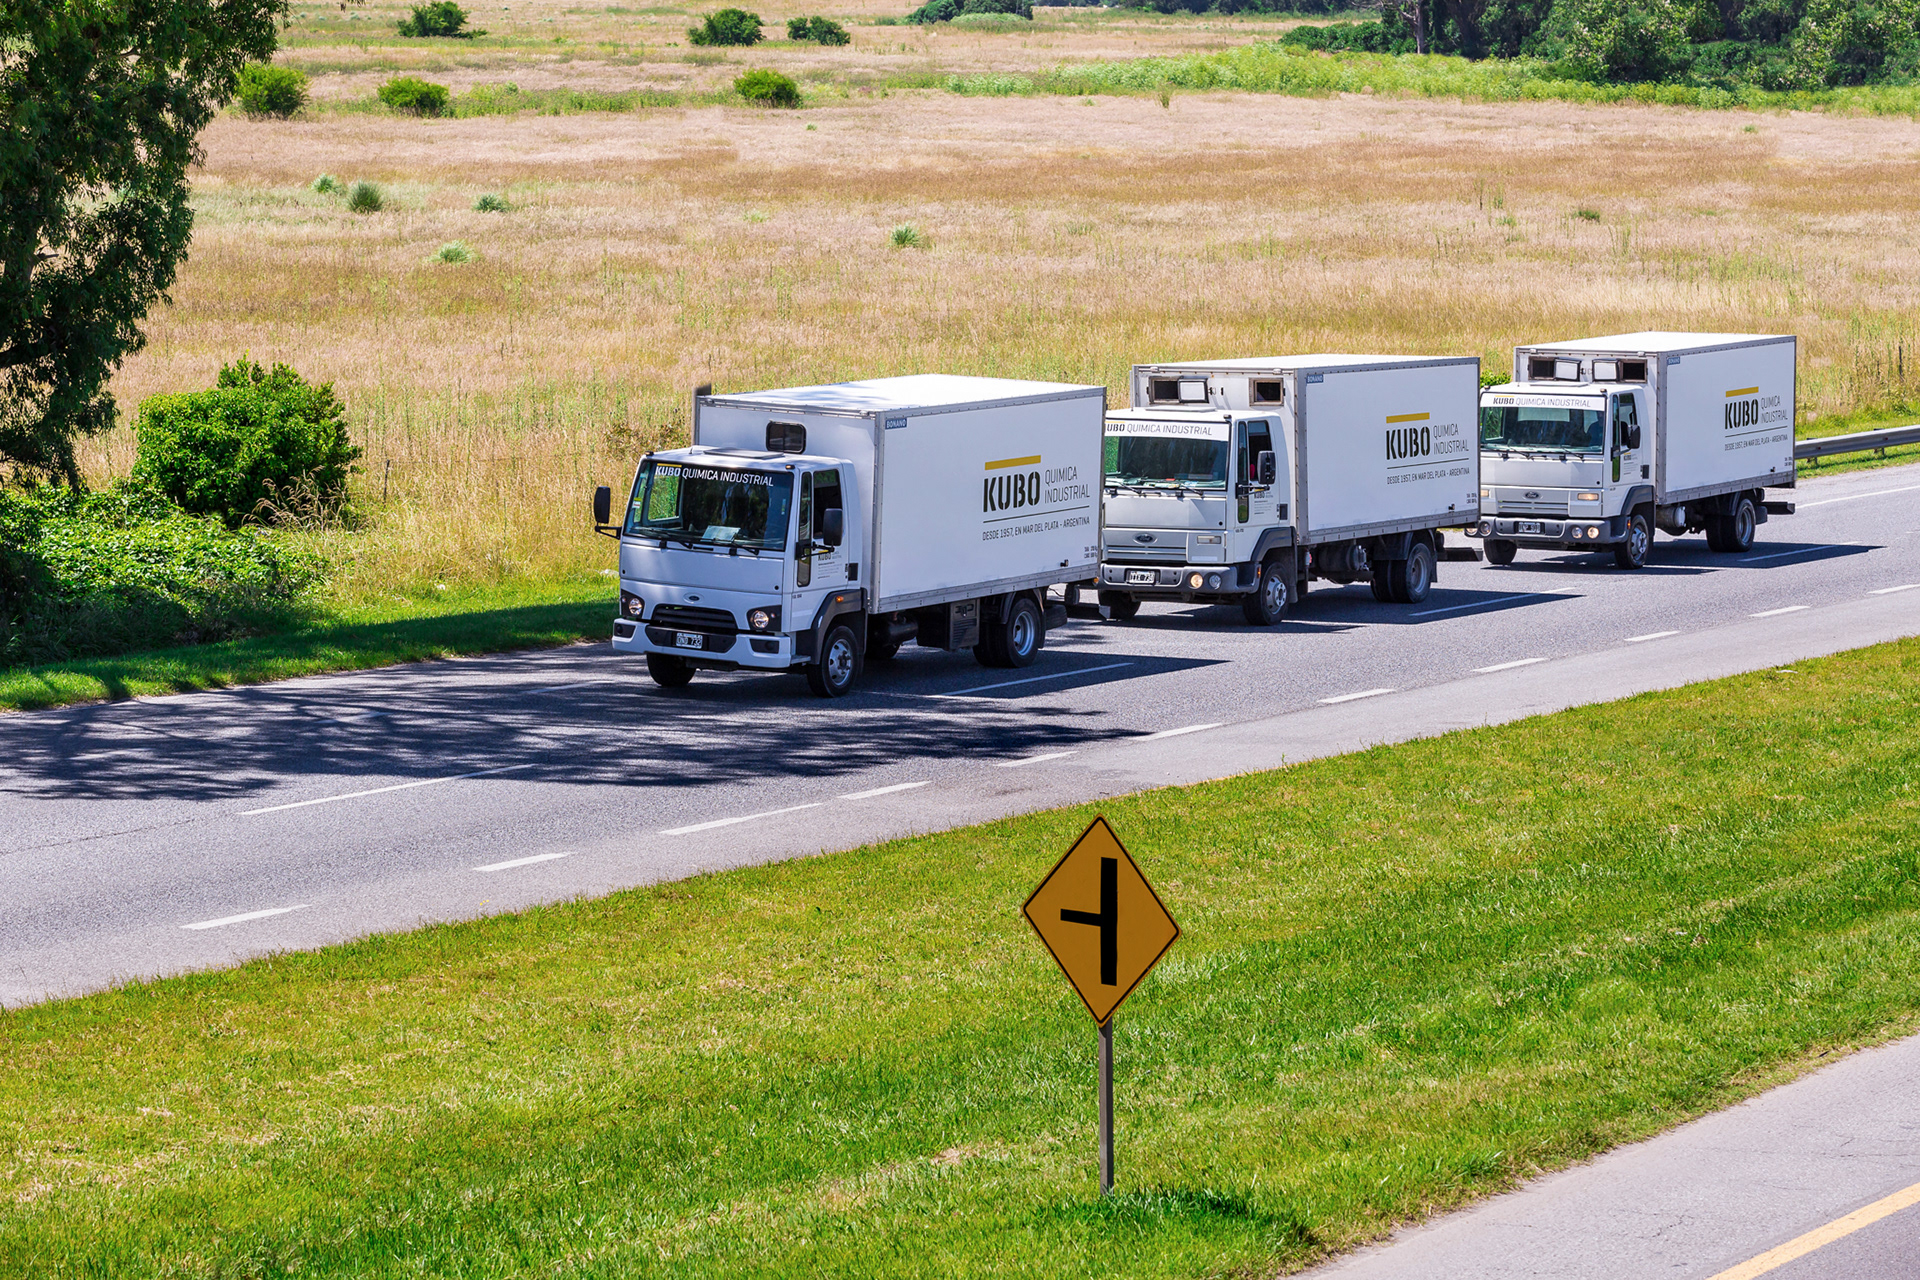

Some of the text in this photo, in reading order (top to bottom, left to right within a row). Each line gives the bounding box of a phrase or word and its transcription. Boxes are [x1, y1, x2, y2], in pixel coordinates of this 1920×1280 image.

[1493, 397, 1591, 407] KUBO QUIMICA INDUSTRIAL
[1725, 399, 1758, 429] KUBO
[1105, 423, 1212, 436] UBO QUIMICA INDUSTRIAL
[1433, 423, 1459, 440] QUIMICA
[1386, 426, 1430, 460] KUBO
[1434, 439, 1469, 455] INDUSTRIAL
[655, 466, 773, 487] KUBO QUIMICA INDUSTRIAL
[1045, 466, 1077, 487] QUIMICA
[1387, 475, 1400, 484] DESDE
[1435, 470, 1446, 479] PLATA
[1449, 467, 1470, 477] ARGENTINA
[983, 471, 1040, 513] KUBO
[1044, 484, 1090, 504] INDUSTRIAL
[982, 529, 999, 541] DESDE
[1000, 527, 1014, 538] 1957,
[1015, 526, 1021, 536] EN
[1022, 524, 1034, 534] MAR
[1034, 522, 1043, 533] DEL
[1044, 520, 1059, 531] PLATA
[1063, 516, 1090, 528] ARGENTINA
